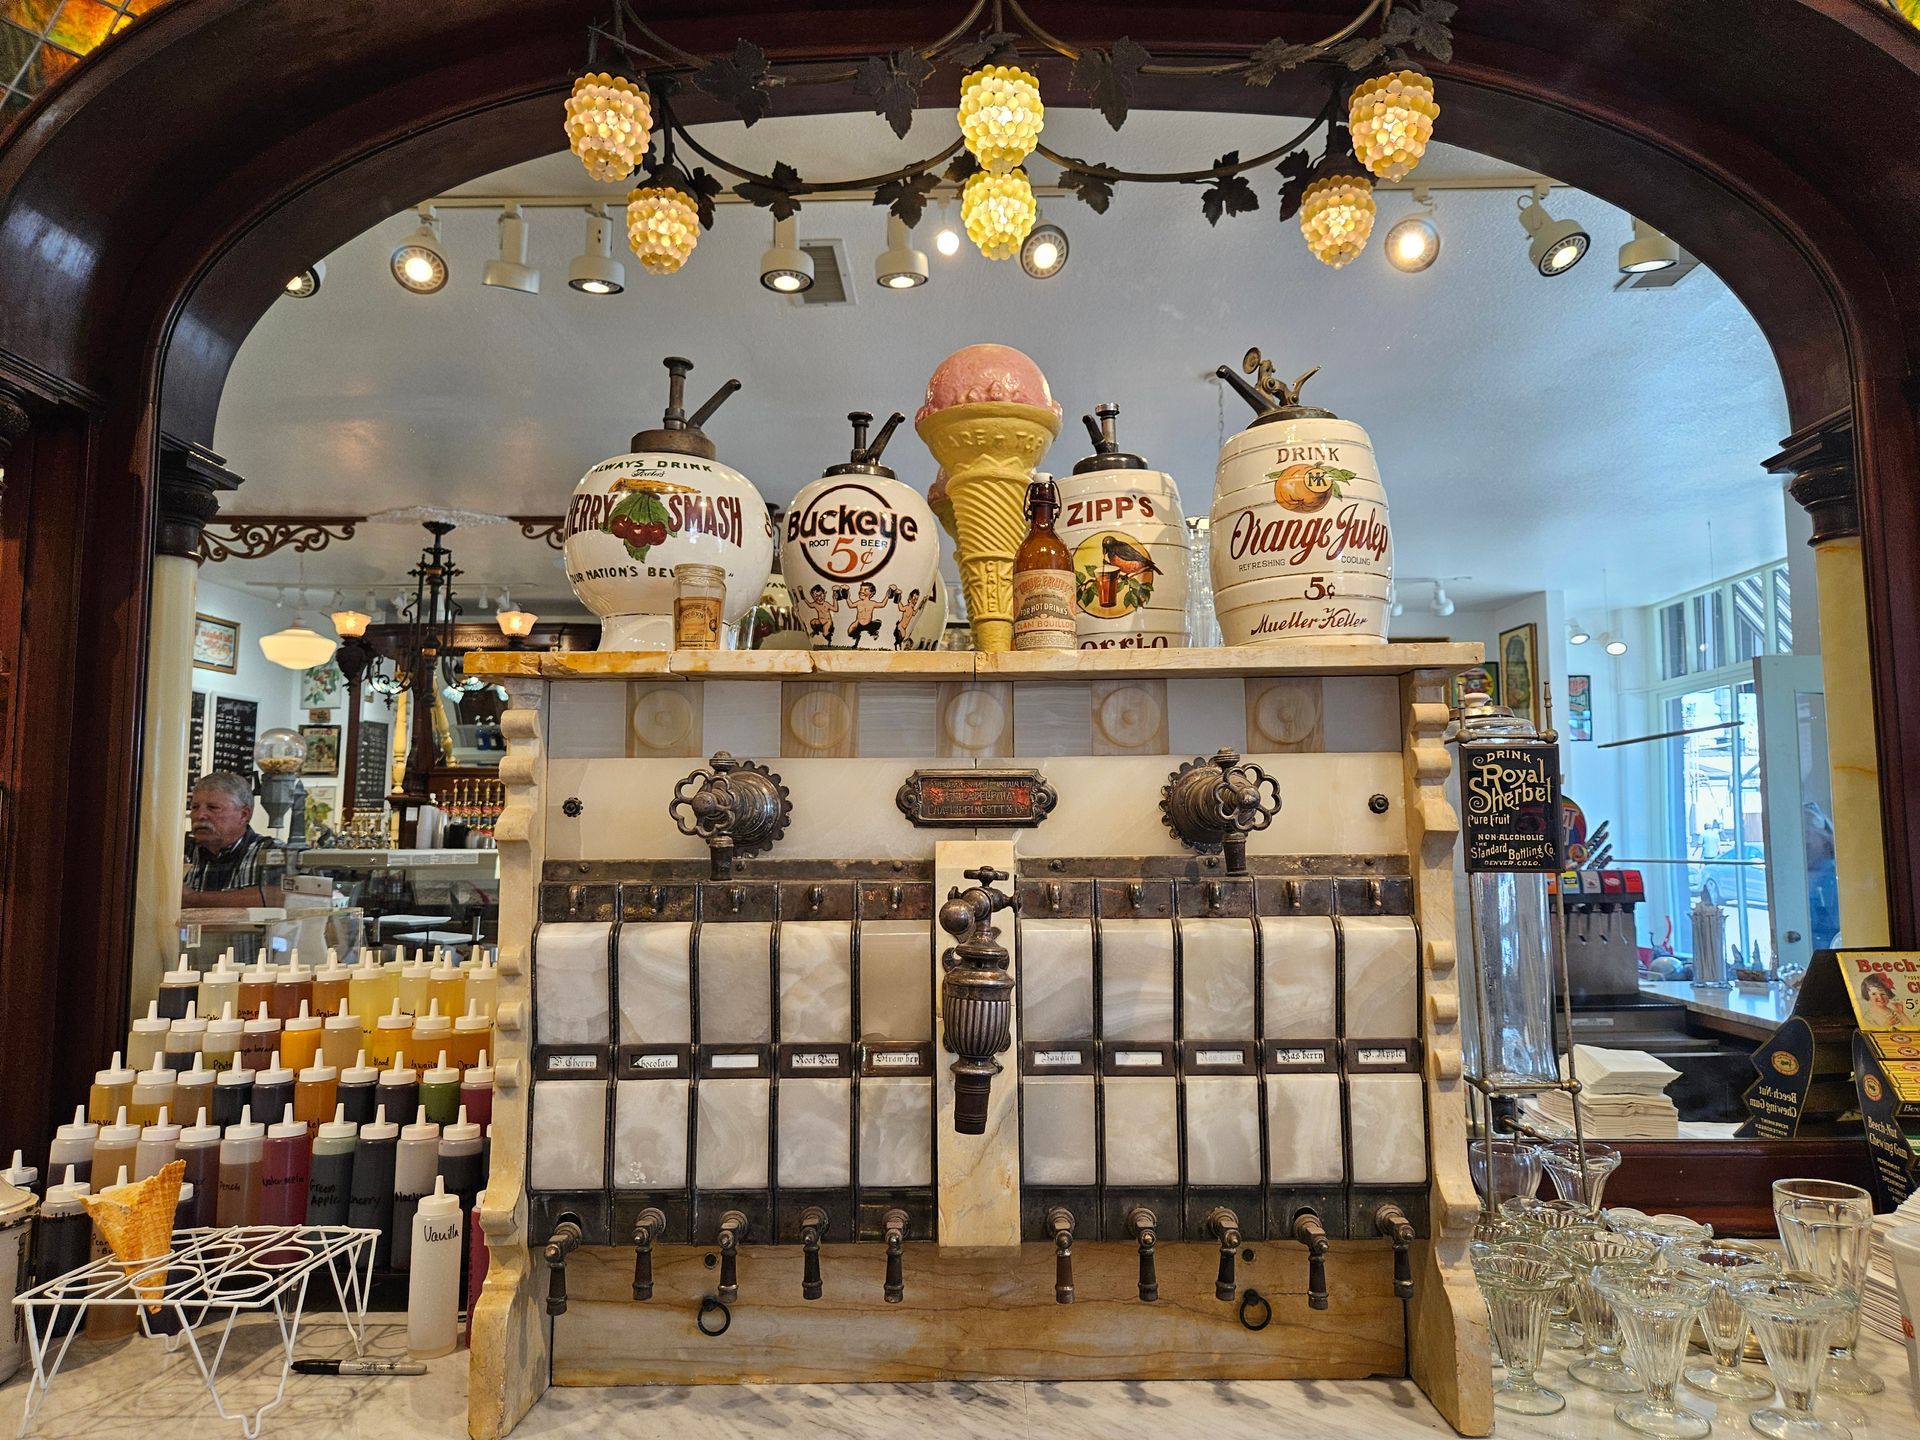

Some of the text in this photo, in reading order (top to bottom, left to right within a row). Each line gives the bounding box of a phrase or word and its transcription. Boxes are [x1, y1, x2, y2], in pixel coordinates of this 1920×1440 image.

[1276, 447, 1340, 464] DRINK
[593, 459, 713, 473] ALWAYS DRINK
[1066, 494, 1155, 527] ZIPP'S
[566, 494, 743, 548] HERRY SMASH
[787, 505, 919, 543] Buckeye
[1230, 503, 1388, 566] Orange Julep
[809, 539, 888, 548] ROOT BEER
[826, 537, 874, 574] 5¢
[1238, 555, 1371, 572] REFRESHING COOLING
[586, 565, 639, 580] NATION'S
[1304, 576, 1336, 600] 5¢
[1020, 603, 1068, 617] FOR HOT DRINKS
[1250, 607, 1369, 636] Mueller-Keller
[1486, 749, 1532, 764] DRINK
[1472, 756, 1546, 795] Royal
[1468, 777, 1552, 814] Sherbet
[1468, 813, 1511, 827] Pure Fruit
[1477, 833, 1545, 841] NON-ALCOHOLIC
[1470, 843, 1508, 859] Standard
[1508, 843, 1545, 861] Bottling
[1856, 958, 1920, 973] Beech-
[638, 1056, 673, 1068] hocolate
[423, 1223, 459, 1242] Vanilla
